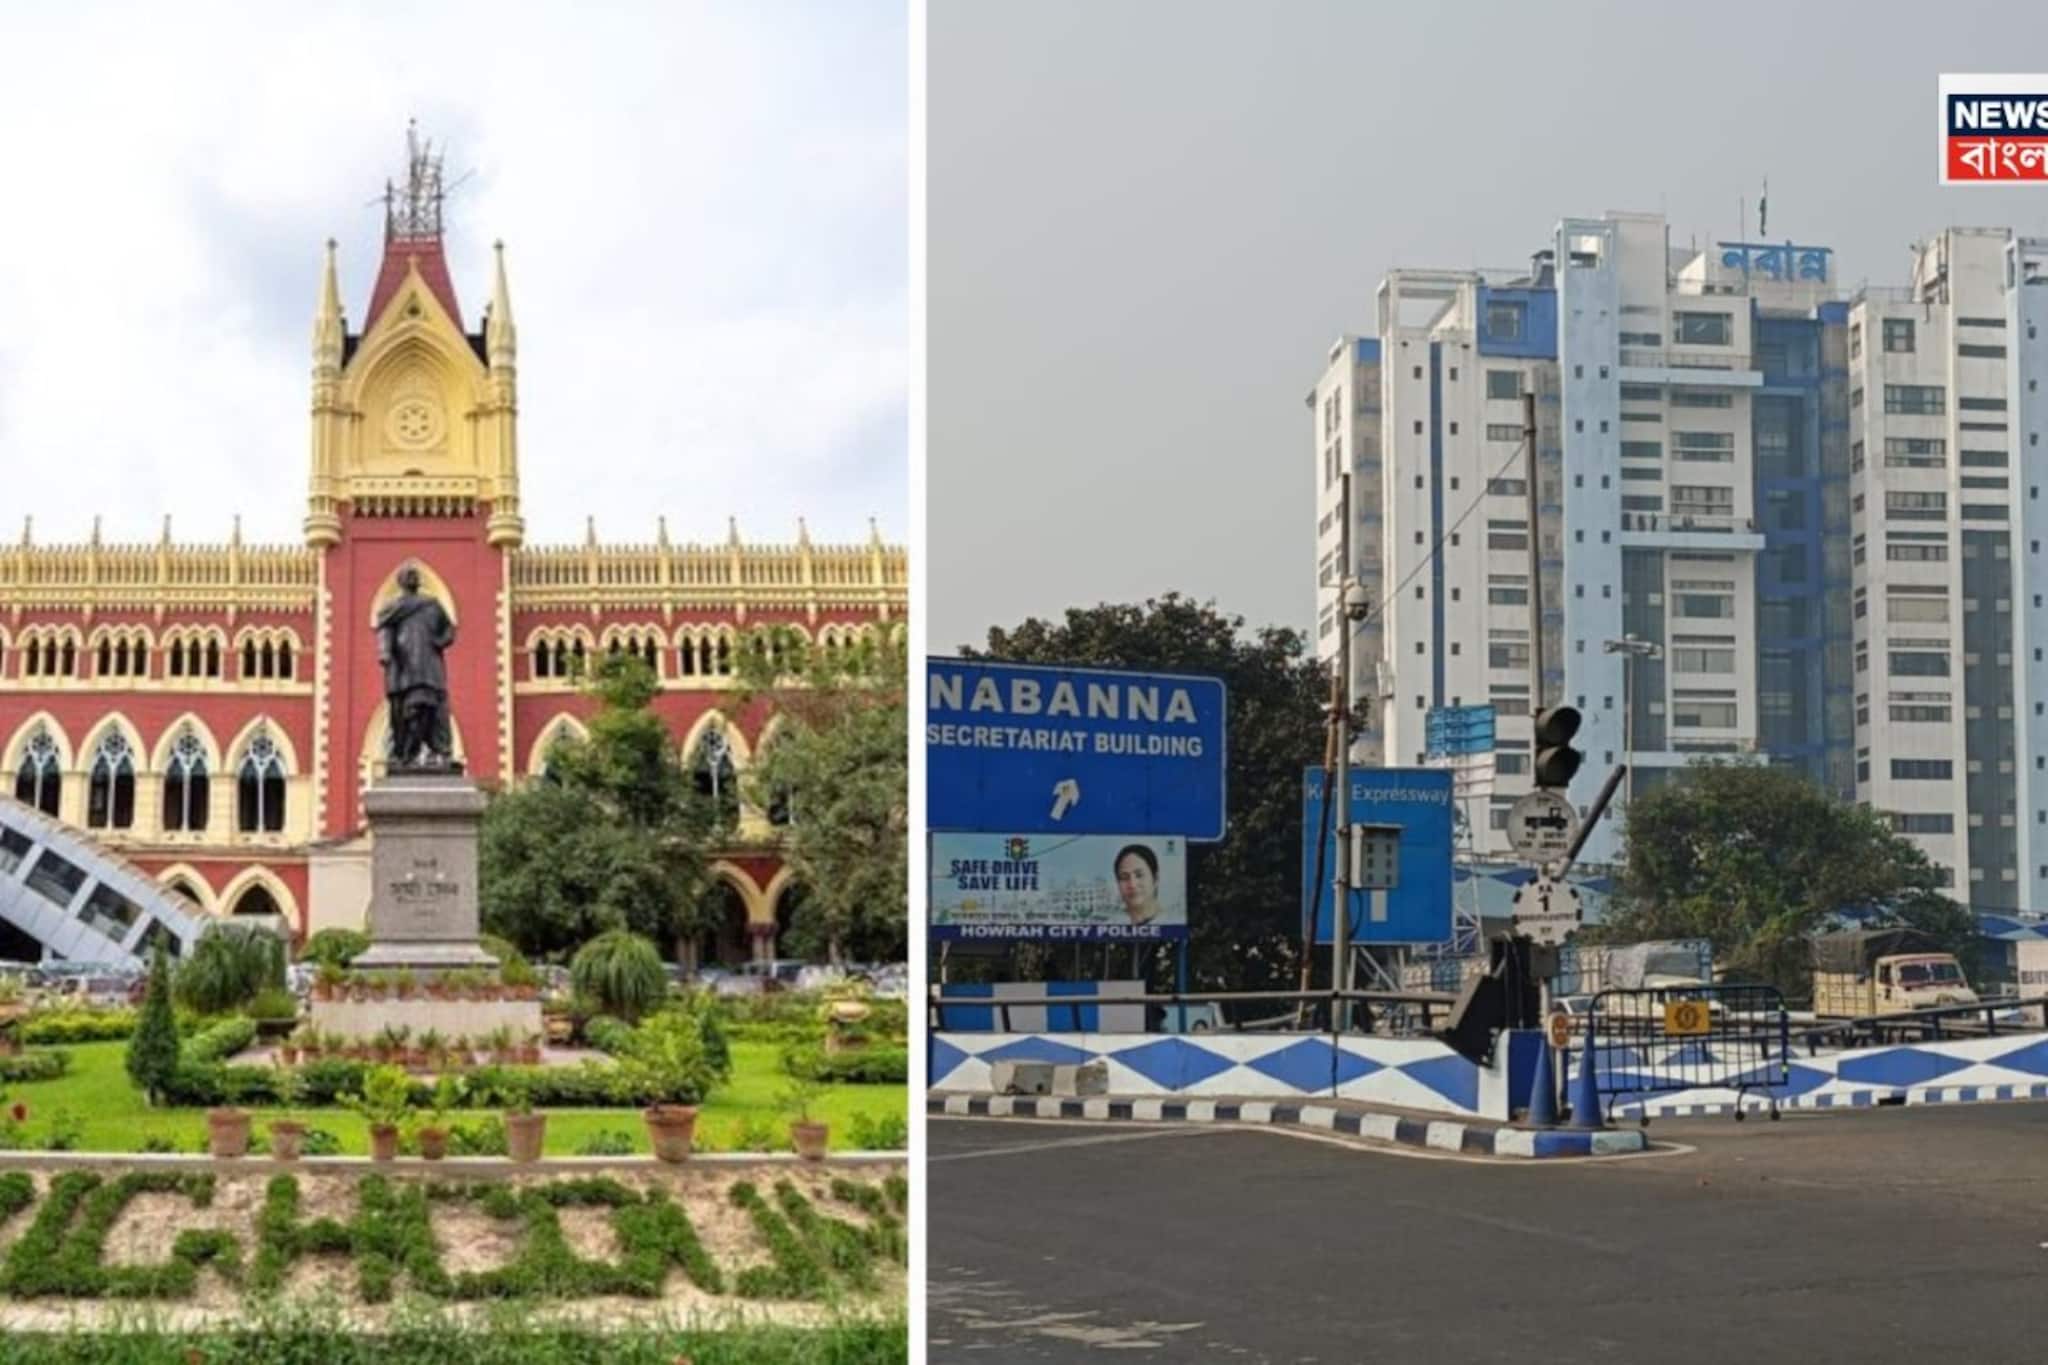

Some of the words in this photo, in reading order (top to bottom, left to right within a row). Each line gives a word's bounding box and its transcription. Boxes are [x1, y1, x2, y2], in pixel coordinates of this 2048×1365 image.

[1716, 239, 1834, 284] নবান্ন
[928, 672, 1198, 724] NABANNA
[927, 722, 1088, 752] SECRETARIAT
[1094, 732, 1203, 757] BUILDING
[1351, 783, 1449, 806] Expressway
[951, 859, 988, 875] SAFE
[991, 859, 1039, 875] DRIVE
[957, 875, 1001, 891] SAVE
[1005, 875, 1039, 891] LIFE
[960, 925, 1044, 938] HOWRAH
[1047, 925, 1092, 938] CITY
[1095, 925, 1161, 938] POLICE
